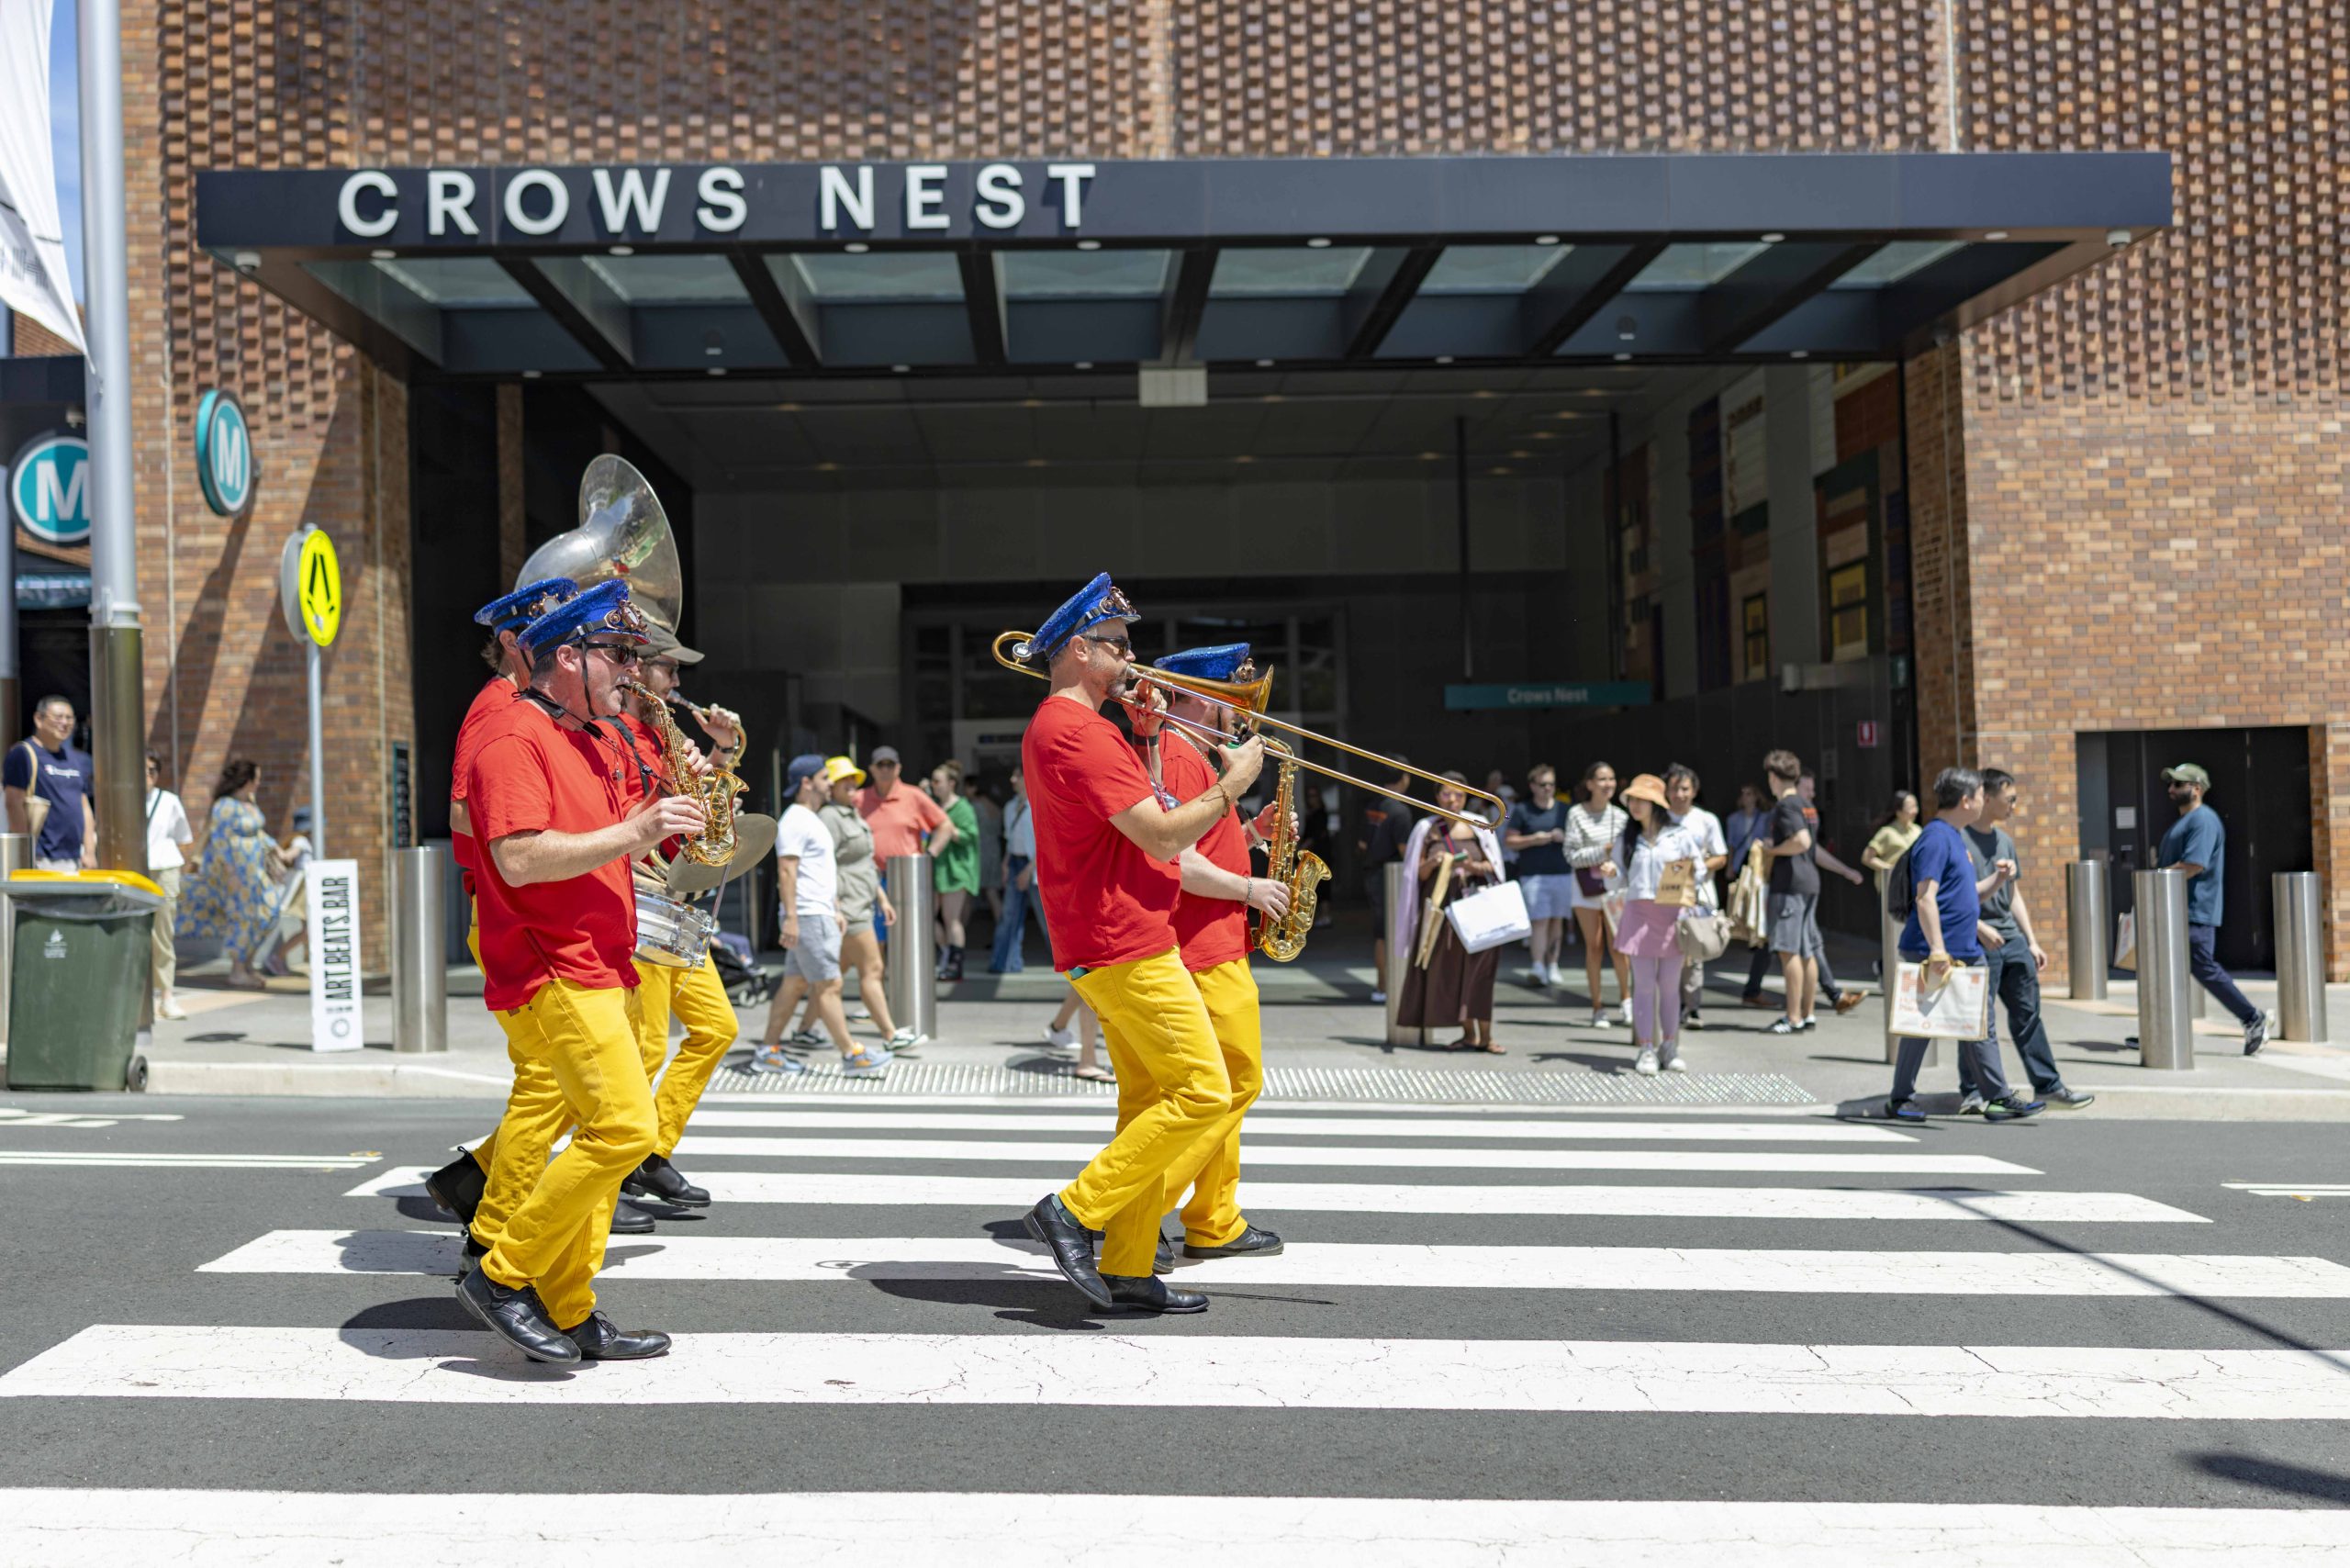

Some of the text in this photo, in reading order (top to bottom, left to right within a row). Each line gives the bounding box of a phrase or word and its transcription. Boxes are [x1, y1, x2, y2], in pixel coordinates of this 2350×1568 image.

[338, 163, 1096, 238] CROWS NEST
[218, 417, 241, 491] M
[36, 460, 90, 521] M
[1507, 687, 1588, 704] Crows Nest
